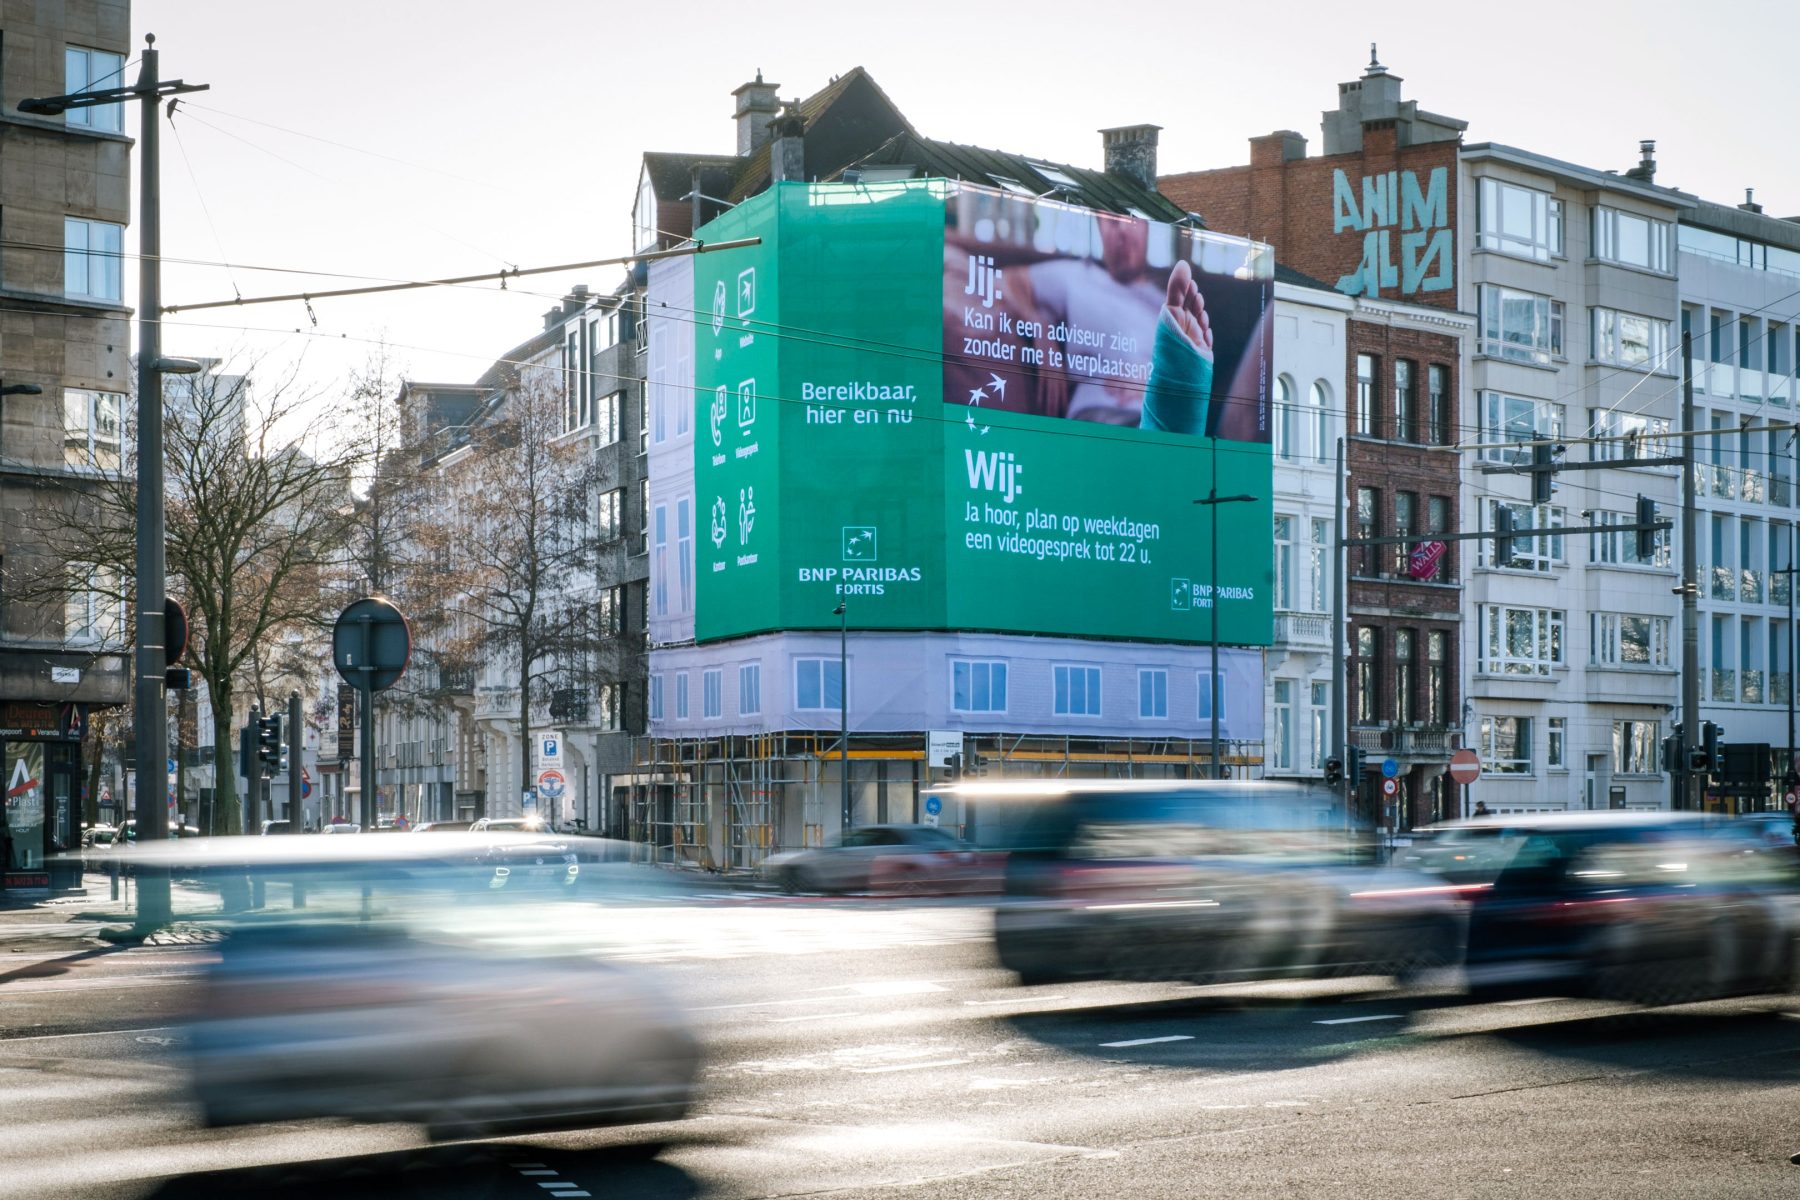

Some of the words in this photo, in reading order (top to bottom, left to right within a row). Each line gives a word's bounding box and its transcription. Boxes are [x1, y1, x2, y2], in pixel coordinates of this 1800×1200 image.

[965, 255, 1003, 308] Jij:
[964, 307, 993, 330] Kan
[999, 313, 1012, 334] ik
[1016, 320, 1041, 338] een
[1048, 323, 1104, 348] adviseur
[1110, 331, 1136, 352] zien
[964, 336, 1016, 360] zonder
[1021, 346, 1043, 365] me
[1049, 347, 1062, 368] te
[1066, 352, 1154, 380] verplaatsen?
[802, 382, 917, 402] Bereikbaar,
[806, 405, 844, 426] hier
[854, 410, 880, 426] en
[887, 410, 913, 426] nu
[965, 449, 1022, 504] Wij:
[965, 501, 979, 523] Ja
[985, 503, 1020, 531] hoor,
[1026, 509, 1057, 530] plan
[1062, 517, 1079, 534] op
[1084, 517, 1159, 542] weekdagen
[966, 532, 992, 549] een
[997, 532, 1090, 561] videogesprek
[1095, 542, 1114, 561] tot
[1119, 543, 1135, 562] 22
[1140, 549, 1151, 564] u.
[1412, 542, 1442, 570] WALLS
[799, 568, 837, 582] BNP
[843, 567, 921, 582] PARIBAS
[836, 584, 884, 595] FORTIS
[1193, 584, 1212, 596] BNP
[1216, 586, 1254, 600] PARIBAS
[1193, 598, 1213, 608] FORTI
